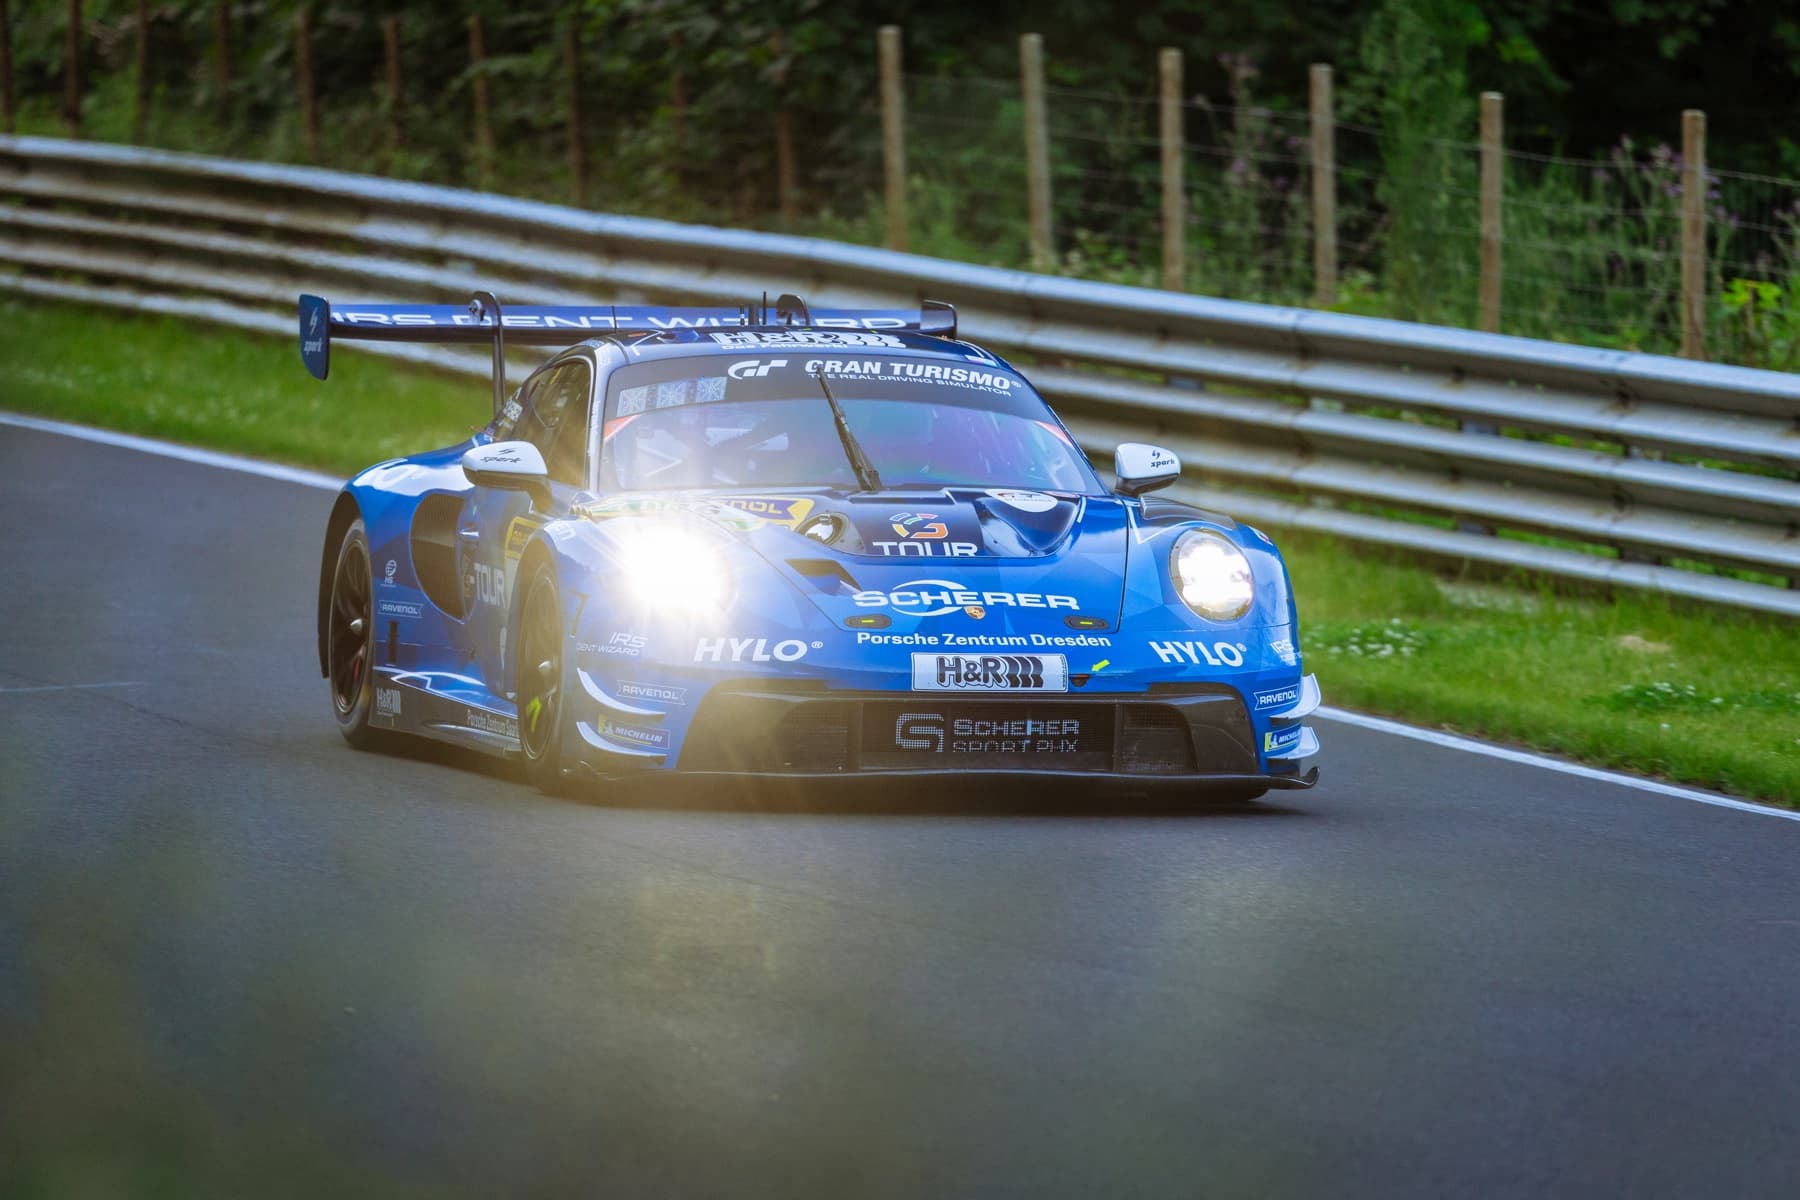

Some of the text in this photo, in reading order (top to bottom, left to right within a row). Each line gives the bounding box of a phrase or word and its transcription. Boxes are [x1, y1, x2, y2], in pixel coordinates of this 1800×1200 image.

[331, 312, 437, 325] IRS
[804, 359, 881, 375] GRAN
[878, 375, 934, 384] DRIVING
[935, 379, 1012, 397] SIMULATOR
[872, 541, 979, 557] TOUR
[852, 590, 1081, 611] SCHERER
[382, 603, 418, 615] RAVENOL
[608, 631, 649, 648] IRS
[856, 632, 1112, 648] Porsche Zentrum Dresden
[598, 645, 641, 656] WIZARD
[622, 685, 680, 700] RAVENOL
[1259, 689, 1297, 705] RAVENOL
[615, 726, 663, 743] MICHELIN
[953, 719, 1080, 737] SCHERER
